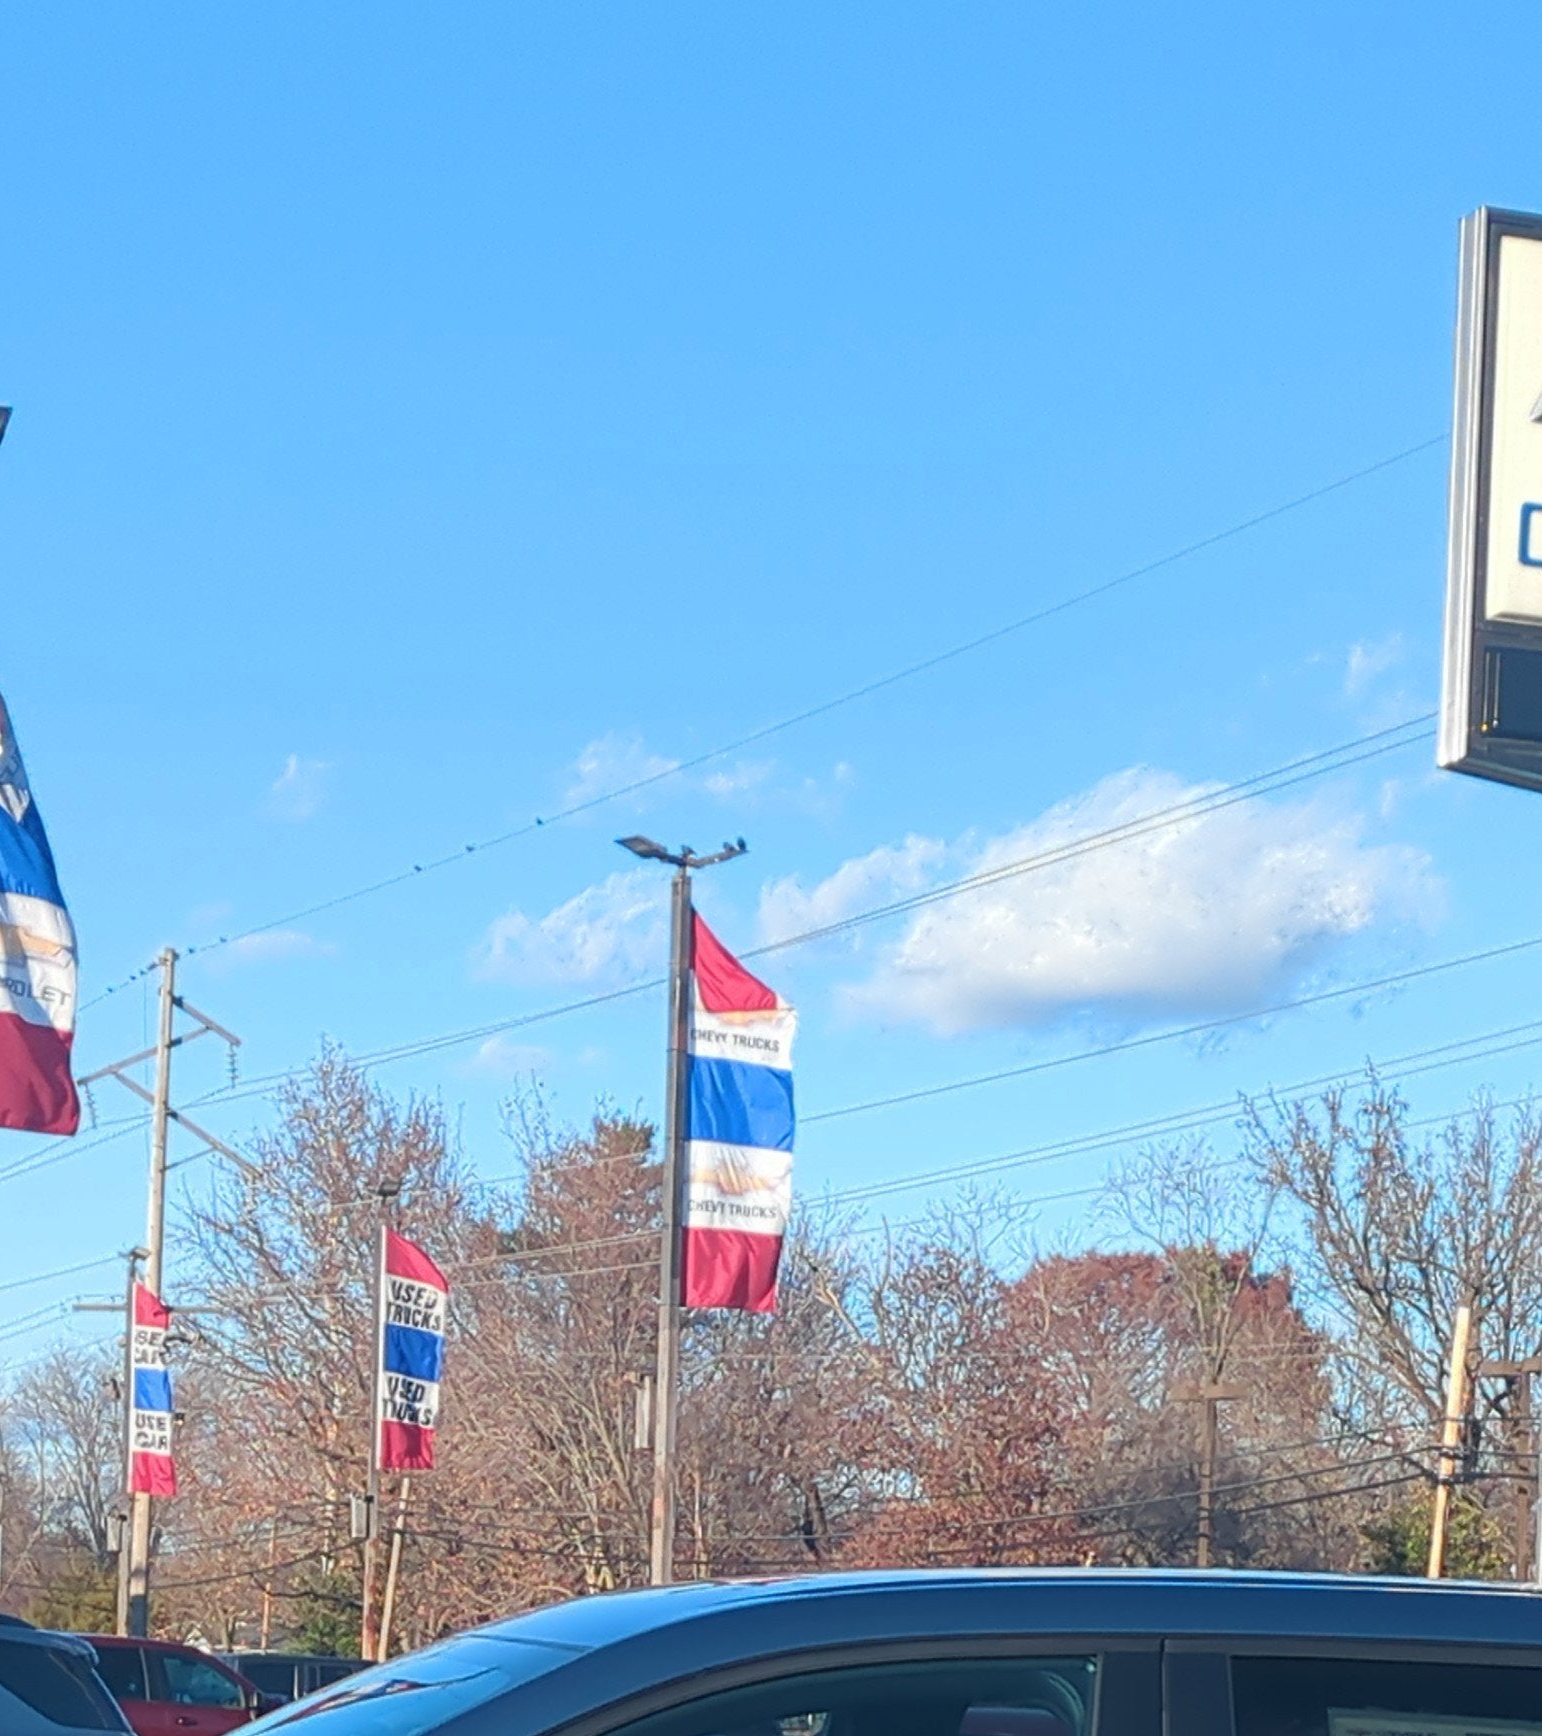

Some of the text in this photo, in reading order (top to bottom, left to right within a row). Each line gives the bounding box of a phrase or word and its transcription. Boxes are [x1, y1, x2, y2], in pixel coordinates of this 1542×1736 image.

[732, 1033, 780, 1052] TRUCKS
[728, 1202, 777, 1218] TRUCKS
[391, 1280, 438, 1310] USED
[386, 1301, 442, 1331] TRUCKS
